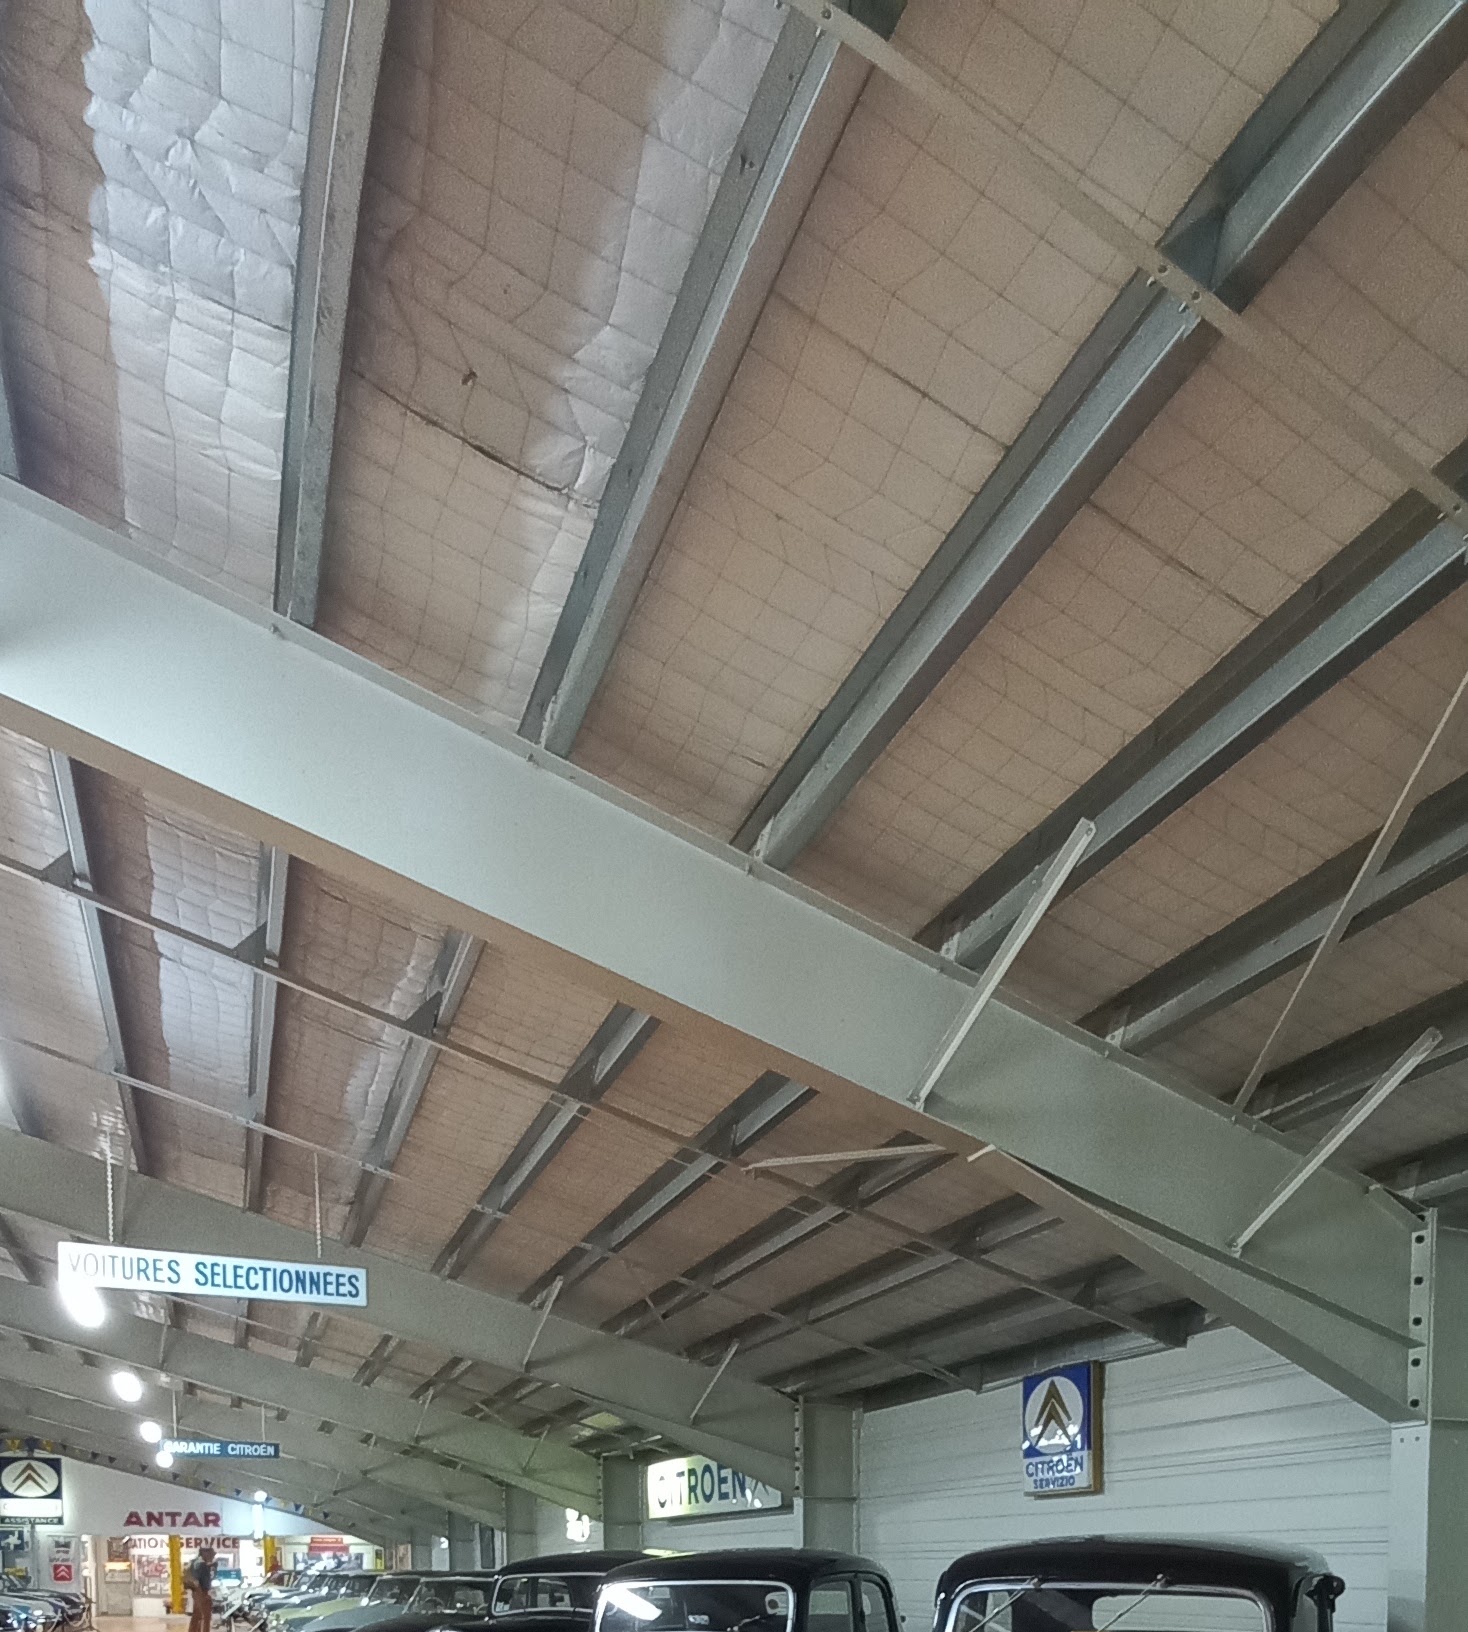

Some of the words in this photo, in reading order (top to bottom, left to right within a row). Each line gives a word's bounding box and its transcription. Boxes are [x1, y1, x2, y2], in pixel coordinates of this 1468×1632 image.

[68, 1252, 182, 1285] VOITURES
[163, 1441, 221, 1455] GARANTIE
[1033, 1475, 1075, 1489] SERVIZIO
[123, 1511, 221, 1528] ANTAR
